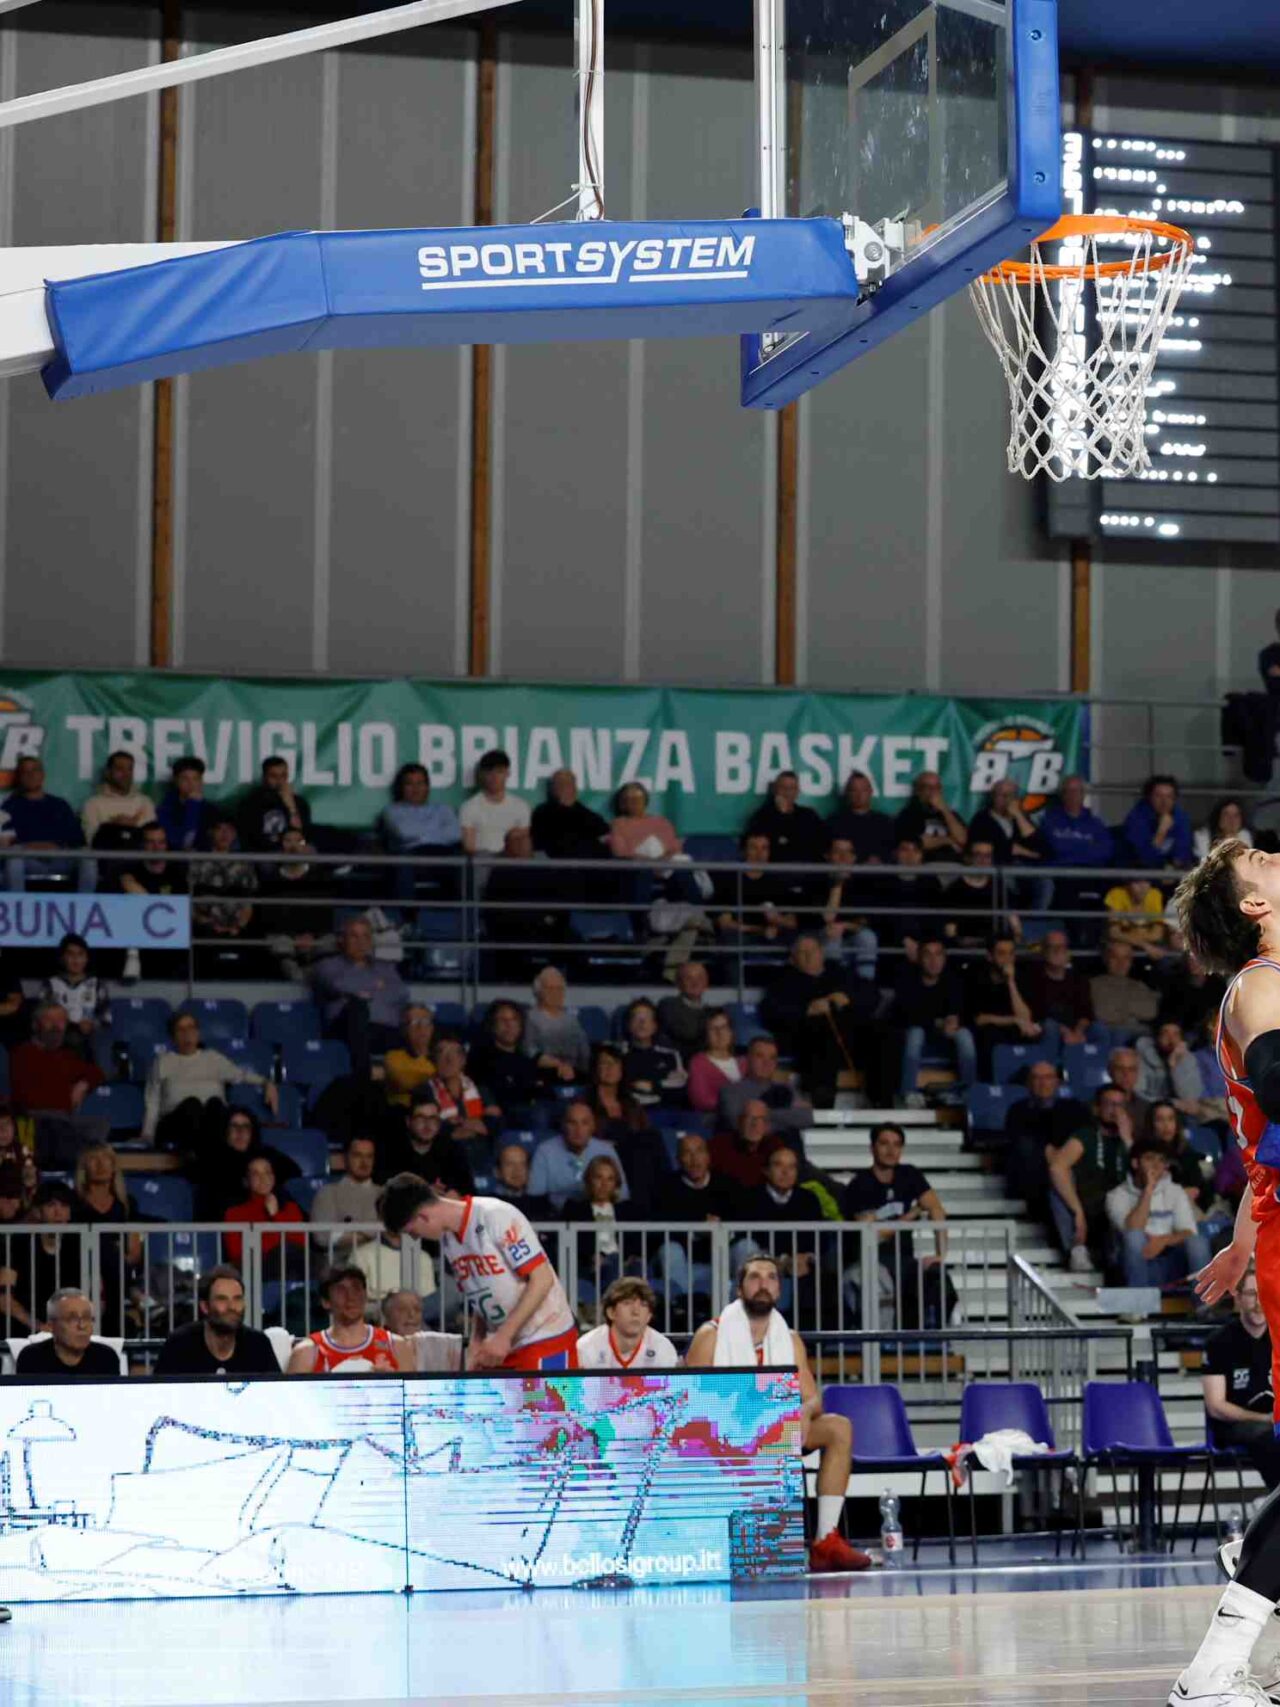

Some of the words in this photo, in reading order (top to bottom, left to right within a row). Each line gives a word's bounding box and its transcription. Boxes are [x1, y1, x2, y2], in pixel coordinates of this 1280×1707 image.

[66, 715, 398, 787] TREVIGLIO
[716, 731, 949, 798] BASKET
[143, 902, 177, 939] C
[508, 1238, 532, 1263] 25
